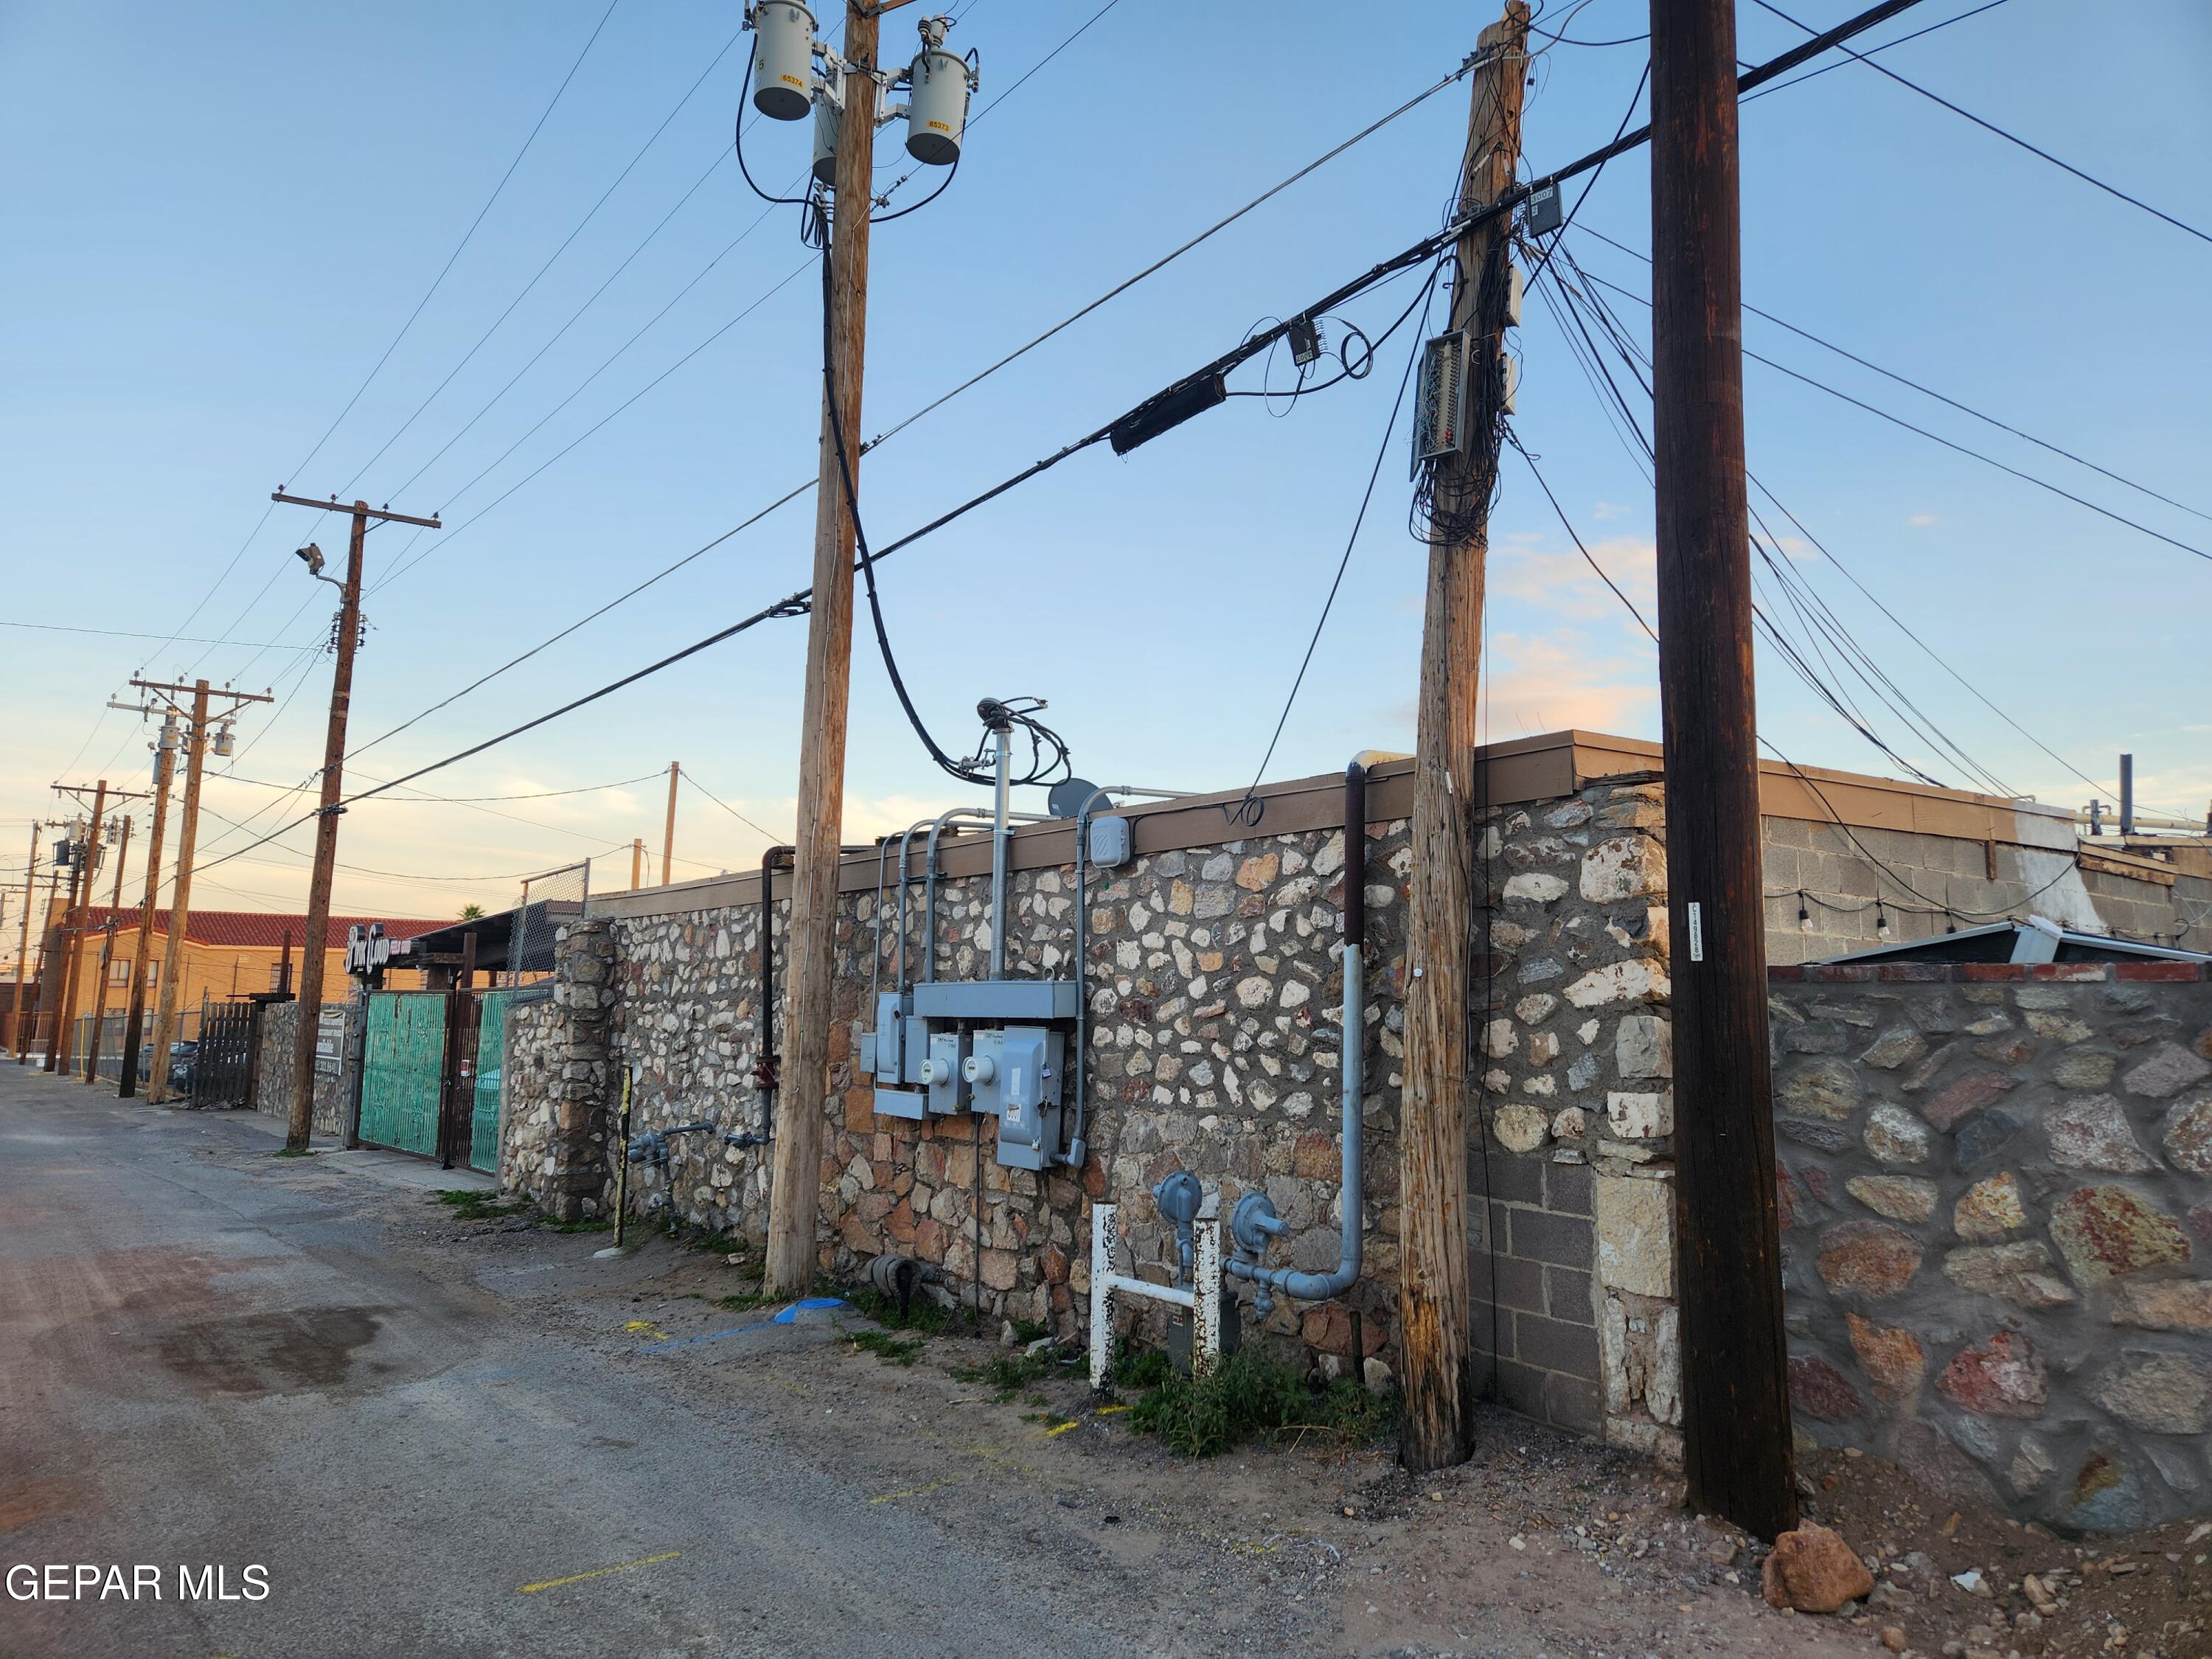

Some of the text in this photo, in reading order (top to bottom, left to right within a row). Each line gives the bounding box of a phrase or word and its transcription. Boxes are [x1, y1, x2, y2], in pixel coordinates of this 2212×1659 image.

[782, 74, 802, 88] 65374
[929, 121, 949, 131] 65373
[1531, 189, 1552, 203] 3007
[1532, 206, 1537, 215] 2
[345, 925, 367, 974] PINK
[366, 923, 390, 975] CLOUD
